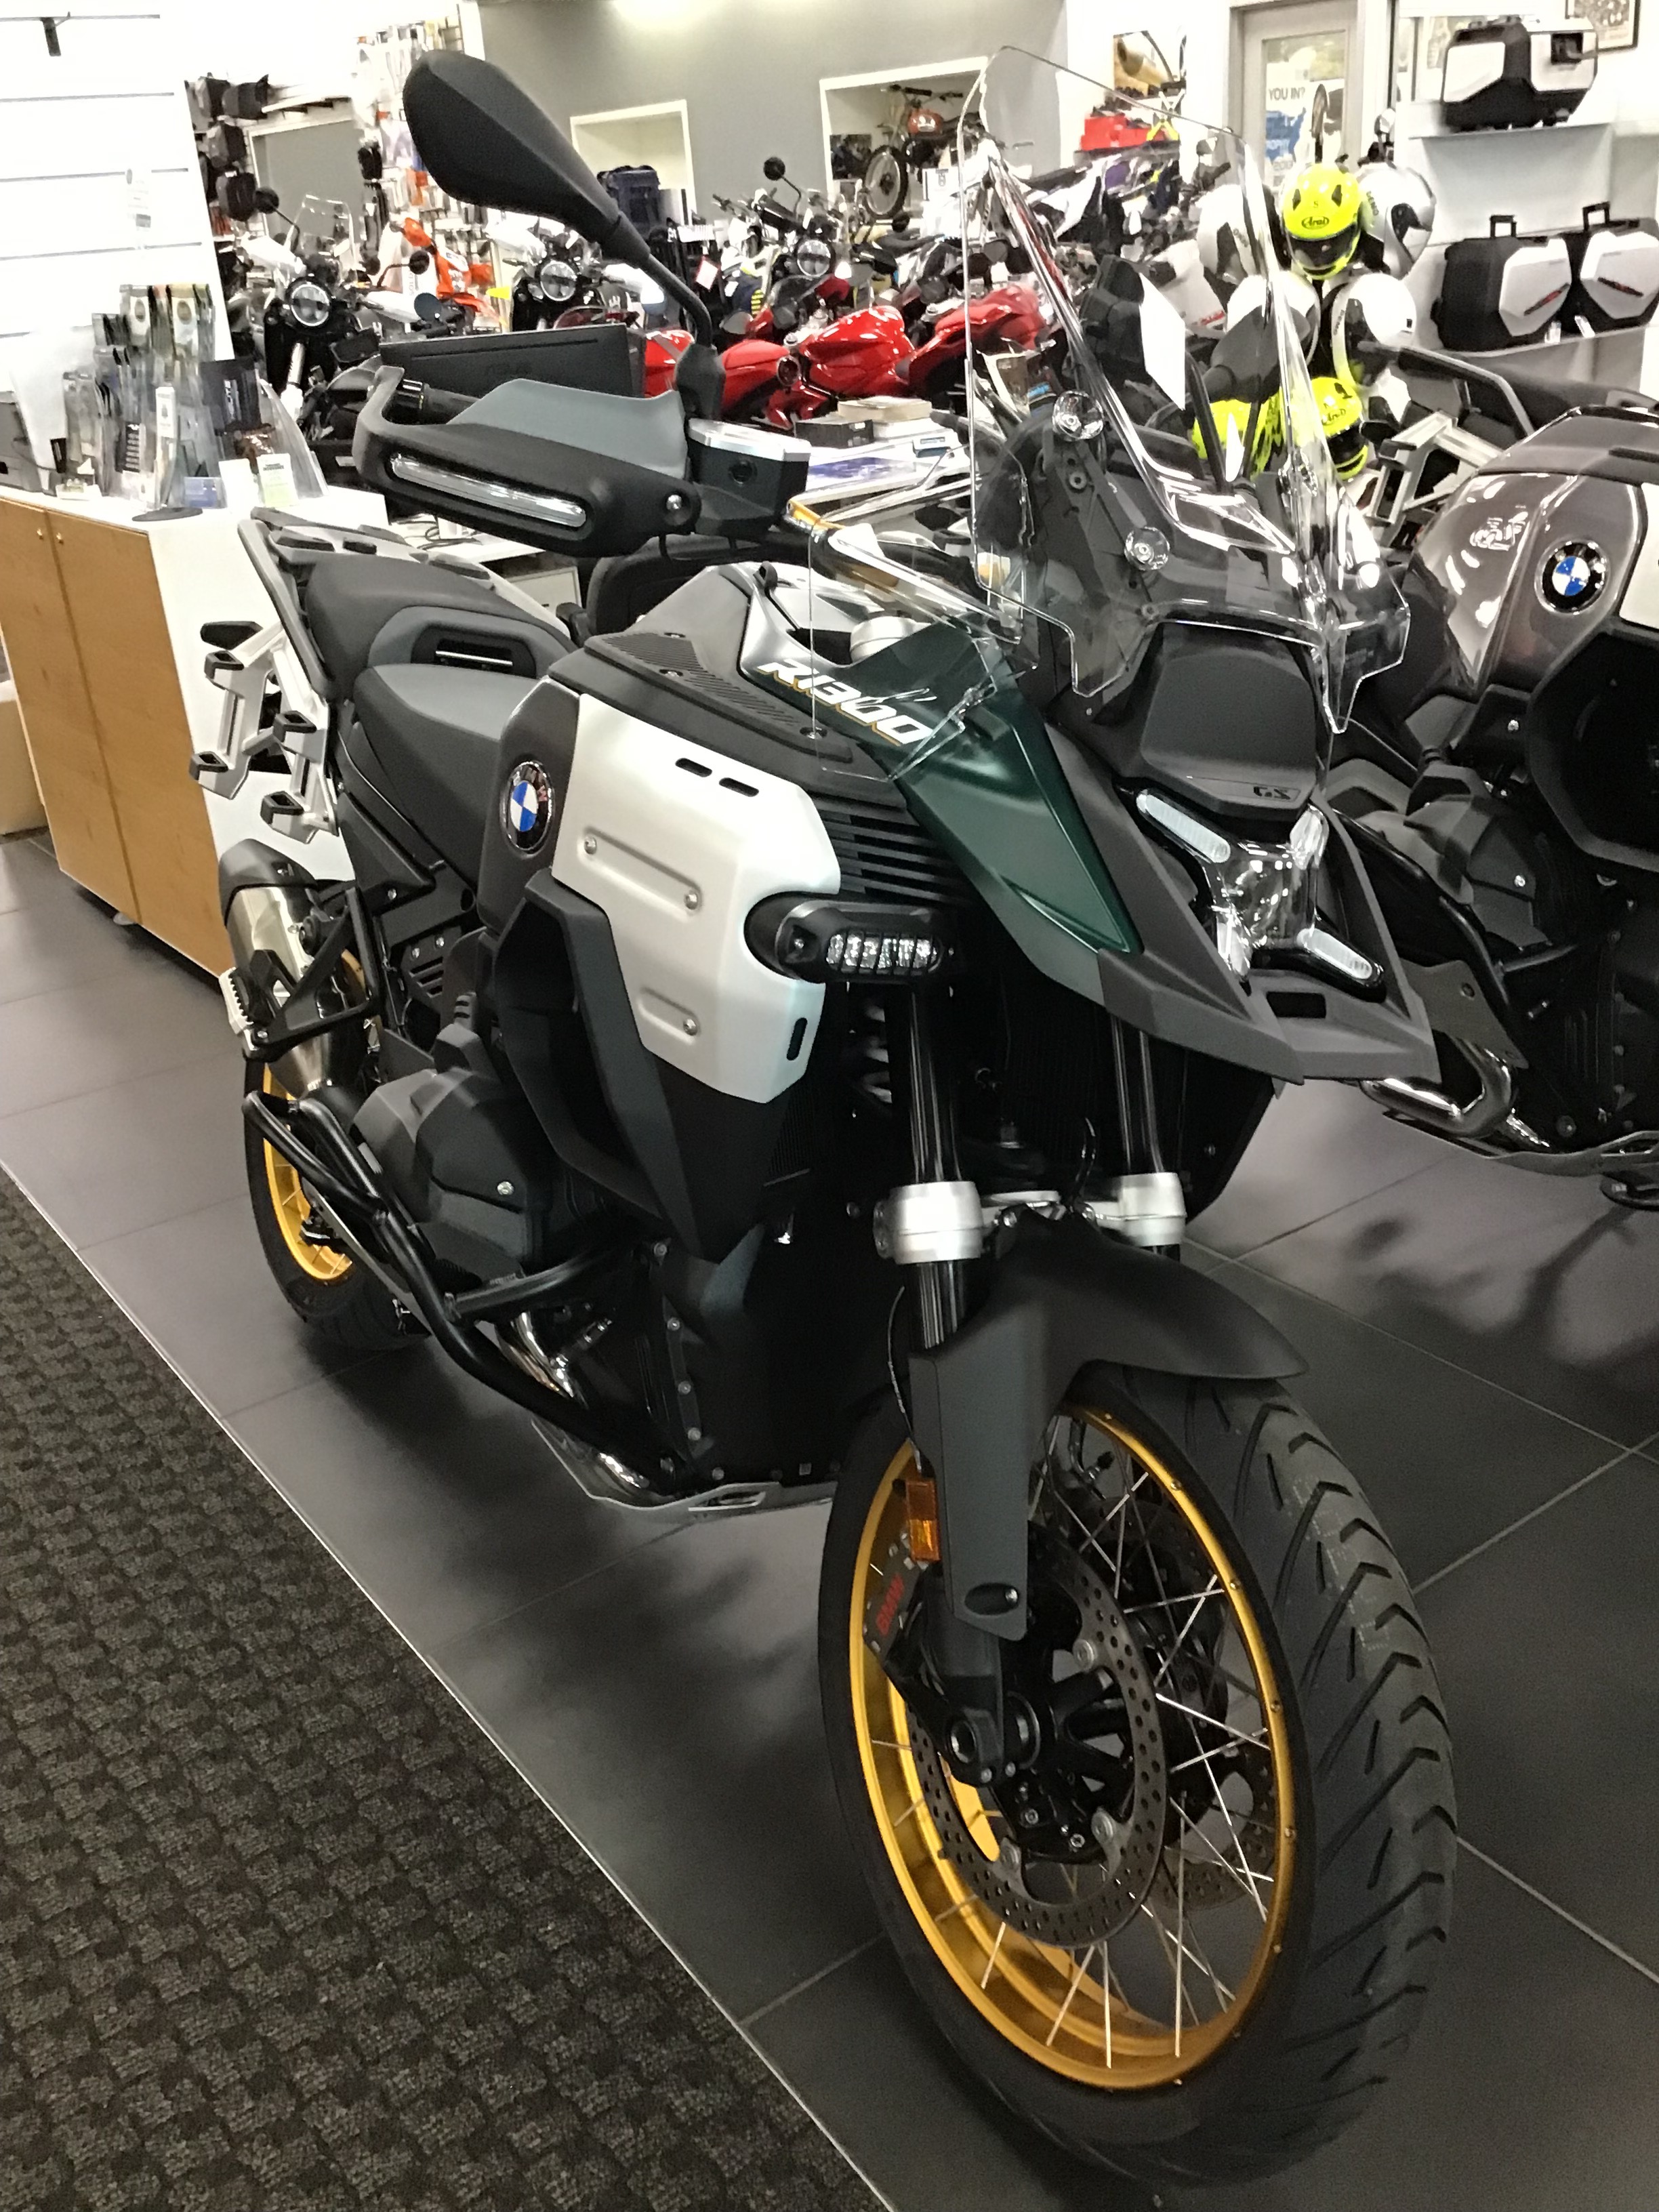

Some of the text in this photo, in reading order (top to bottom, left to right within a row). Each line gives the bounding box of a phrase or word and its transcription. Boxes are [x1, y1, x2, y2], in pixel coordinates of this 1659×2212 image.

[1269, 87, 1306, 100] YOU IN?
[1303, 216, 1328, 228] Arai
[1253, 786, 1291, 800] GS
